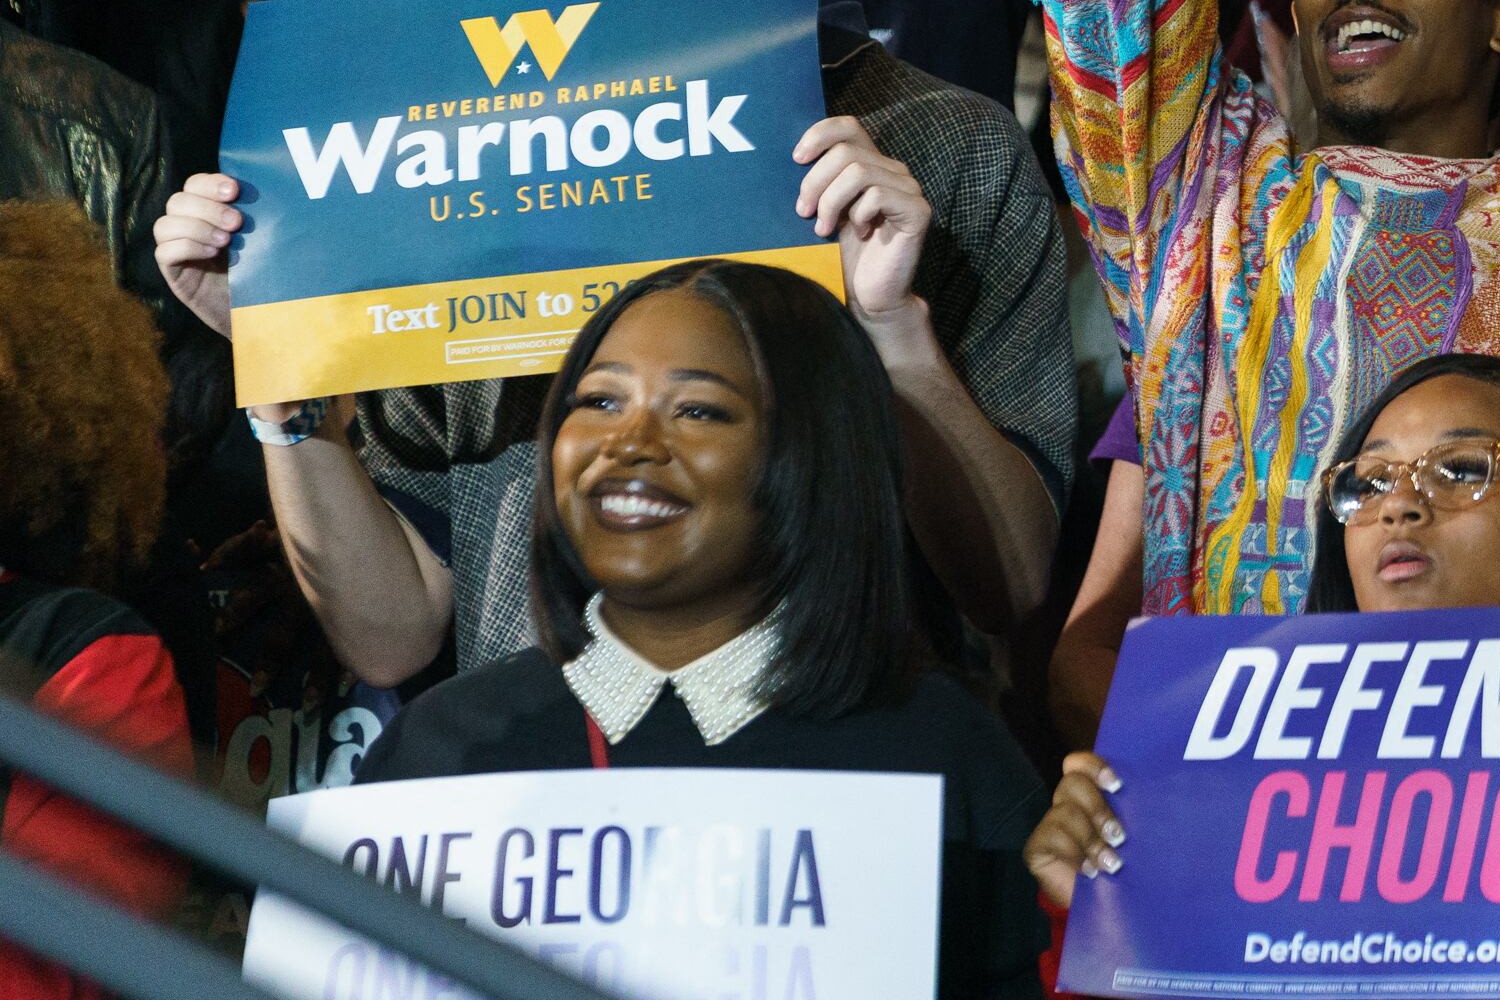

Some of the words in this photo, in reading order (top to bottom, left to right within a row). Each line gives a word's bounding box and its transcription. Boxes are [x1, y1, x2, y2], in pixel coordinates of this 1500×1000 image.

[408, 91, 544, 121] REVEREND
[557, 75, 678, 104] RAPHAEL
[282, 79, 756, 200] Warnock
[430, 192, 499, 221] U.S.
[516, 173, 654, 213] SENATE
[367, 302, 440, 334] Text
[446, 290, 527, 333] JOIN
[536, 291, 573, 318] to
[503, 341, 547, 352] WARNOCK
